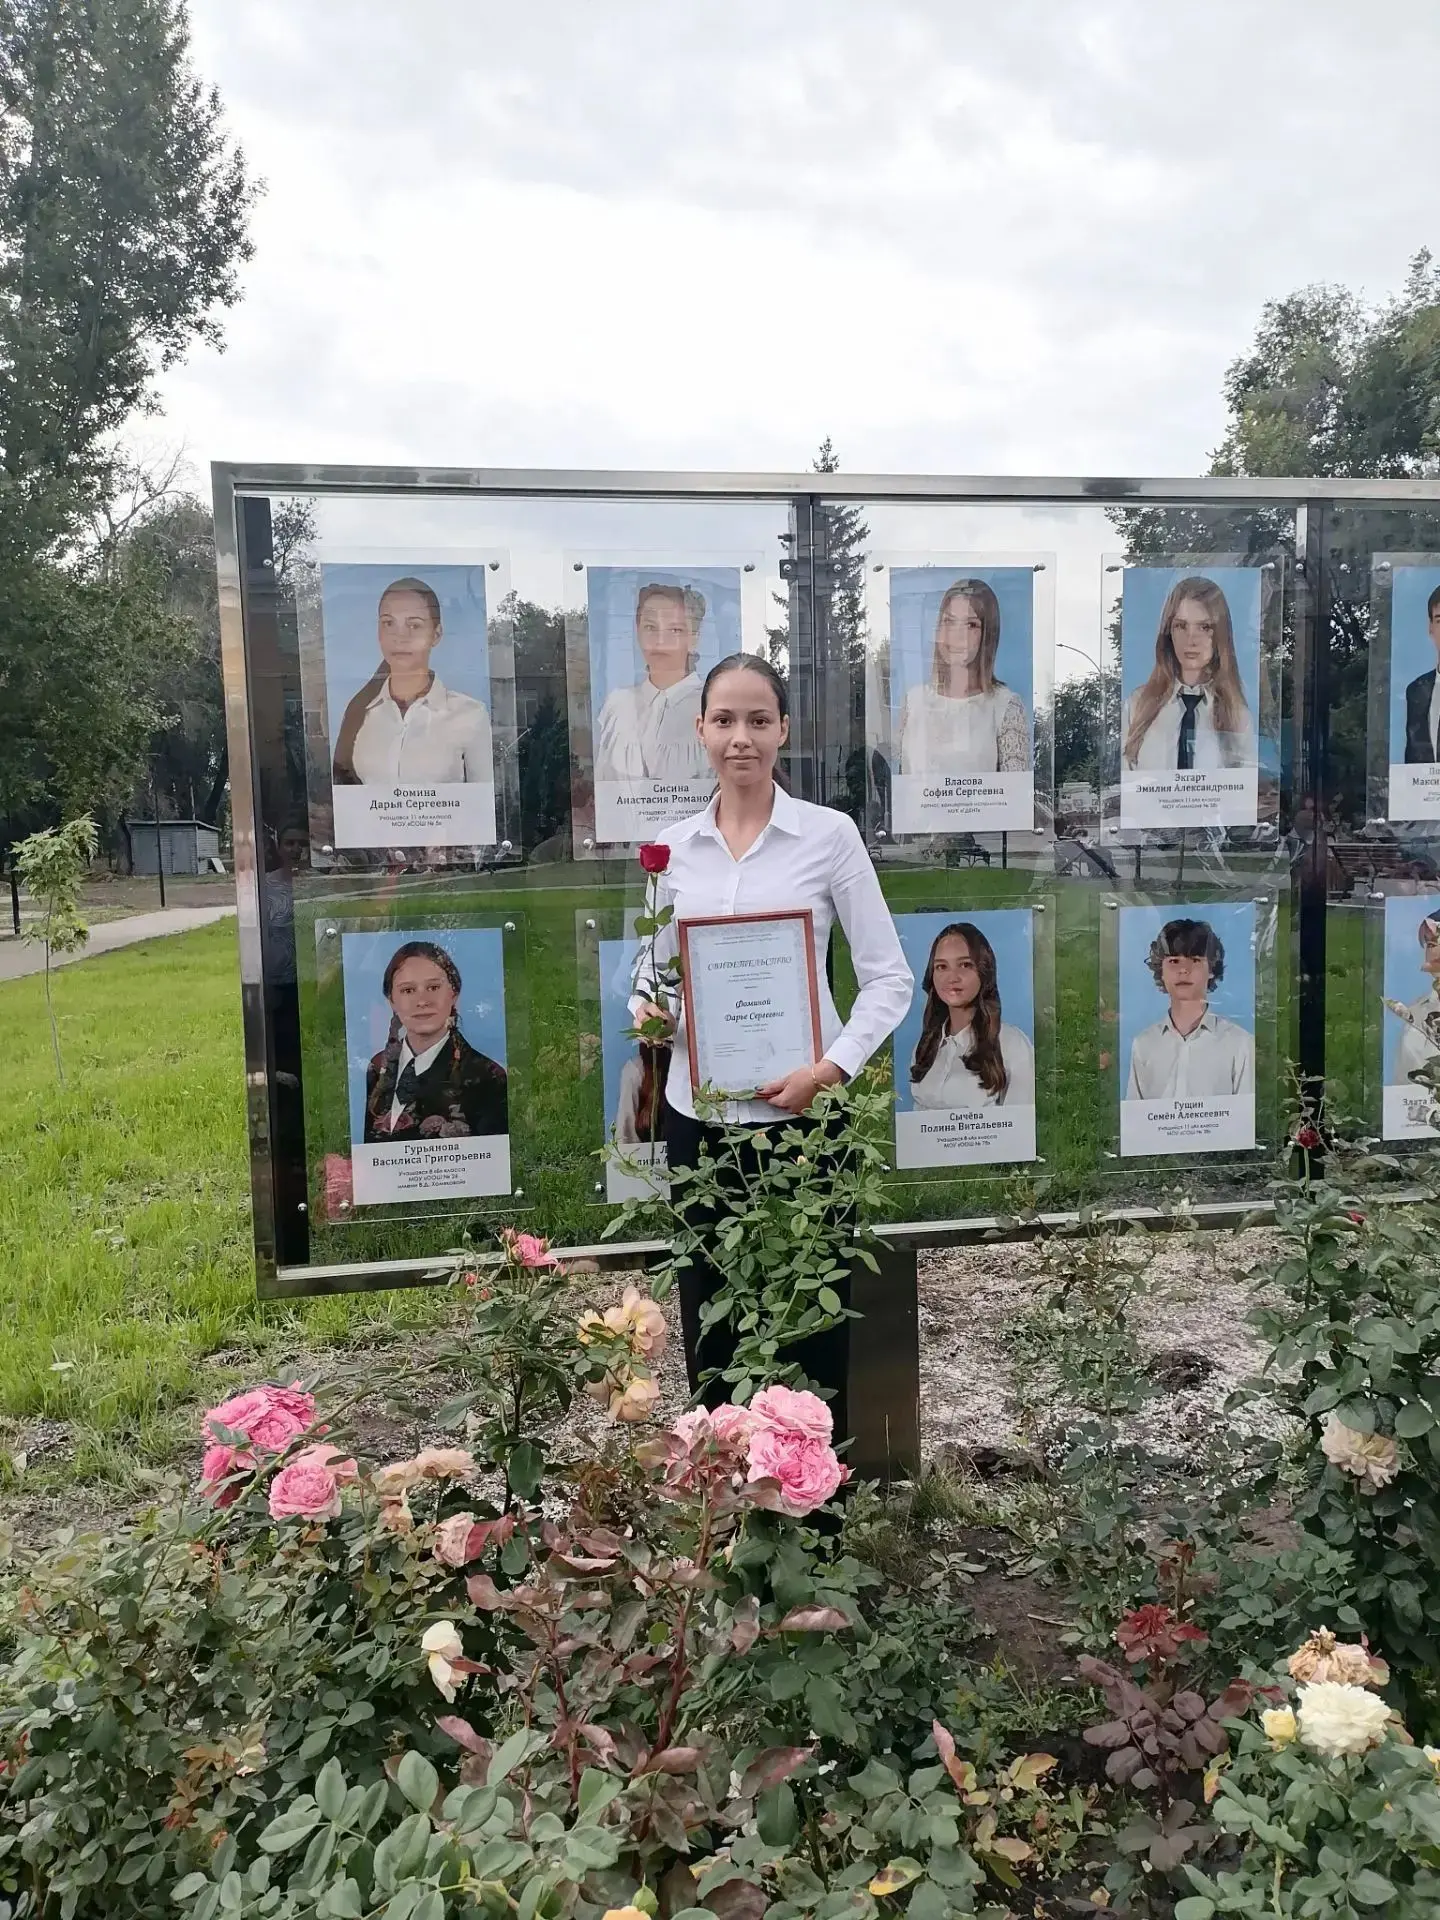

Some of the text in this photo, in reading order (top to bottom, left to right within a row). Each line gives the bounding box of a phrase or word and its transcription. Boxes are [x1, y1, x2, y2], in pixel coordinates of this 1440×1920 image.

[945, 777, 983, 786] Власова
[1174, 773, 1207, 783] Экгарт
[393, 788, 436, 797] Фомина
[653, 784, 689, 793] Сисина
[923, 787, 1004, 798] София Сергеевна
[1136, 783, 1244, 793] Эмилия Александровна
[369, 799, 460, 810] Дарья Сергеевна
[616, 795, 669, 805] Анастасия
[707, 956, 792, 971] СВИДЕТЕЛЬСТВО
[724, 1011, 785, 1023] Дарье Сергеевне
[1174, 1101, 1204, 1111] Гущин
[949, 1112, 984, 1121] Сычёва
[1147, 1110, 1230, 1121] Семён Алексеевич
[920, 1120, 1013, 1133] Полина Витальевна
[404, 1143, 460, 1155] Гурьянова
[372, 1152, 492, 1167] Василиса Григорьевна
